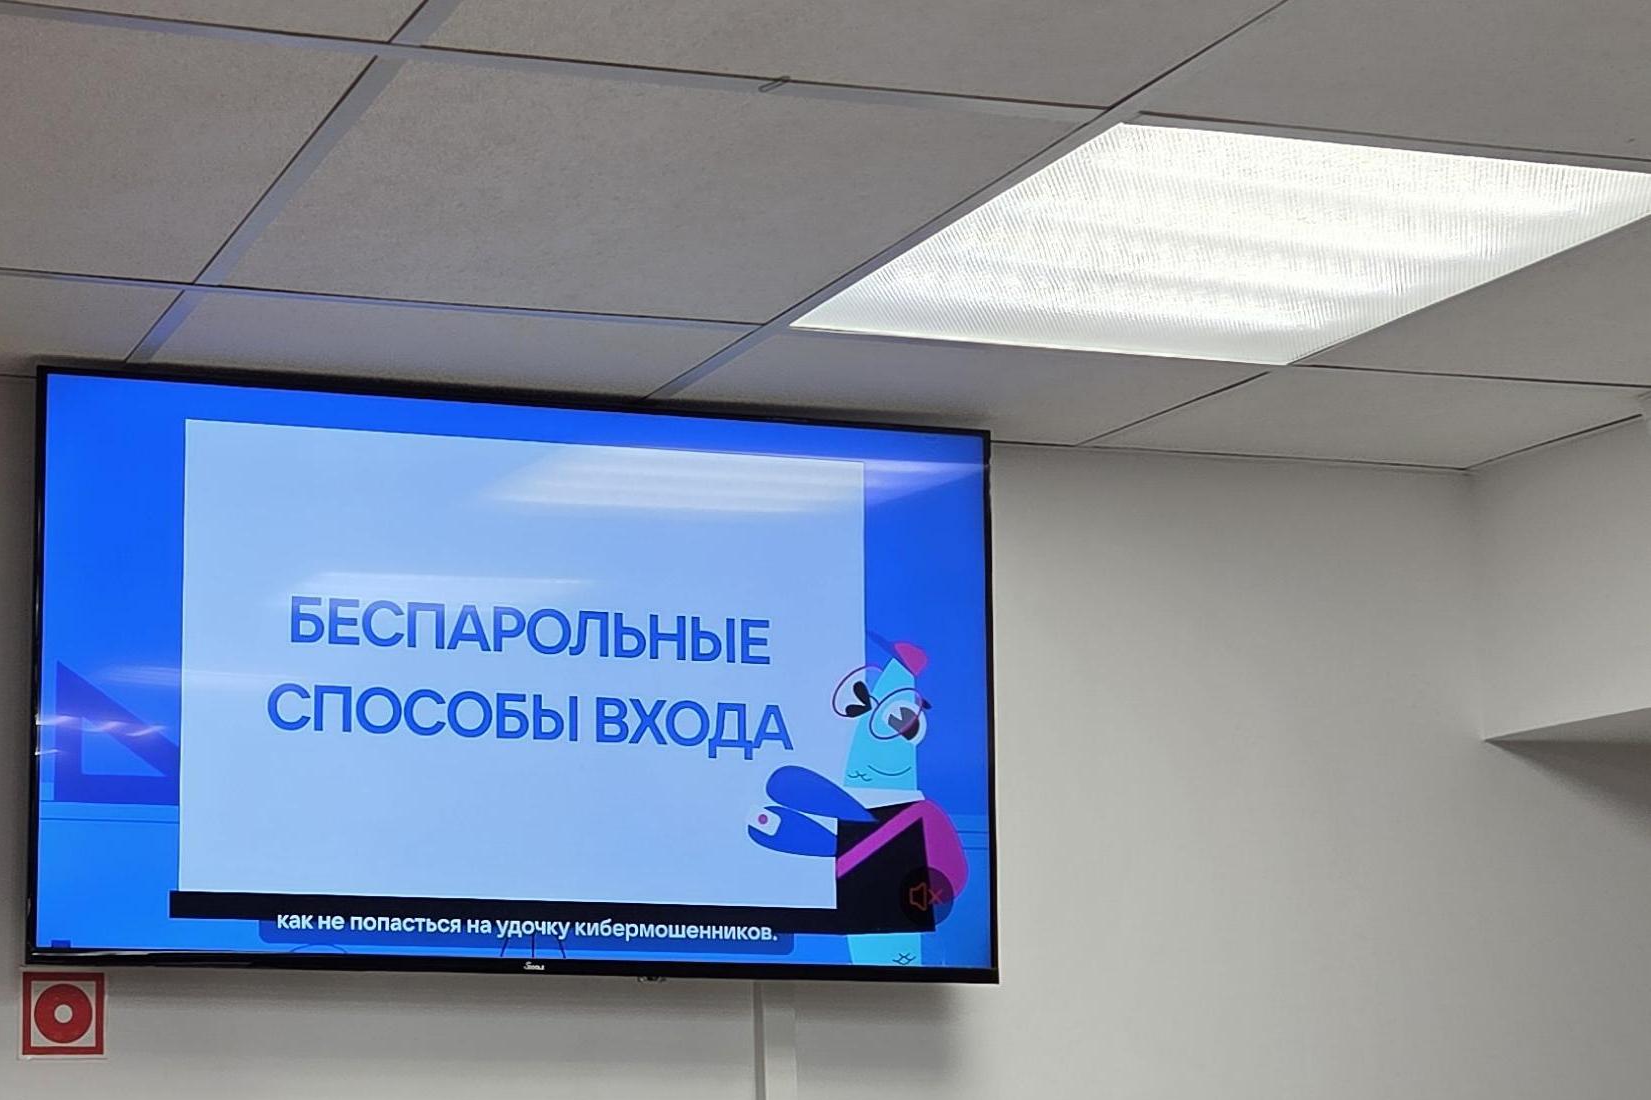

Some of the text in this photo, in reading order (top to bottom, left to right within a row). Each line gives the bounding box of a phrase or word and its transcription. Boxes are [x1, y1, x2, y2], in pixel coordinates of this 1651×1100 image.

[290, 595, 771, 665] БЕСПАРОЛЬНЫЕ
[266, 683, 794, 760] СПОСОБЫ ВХОДА
[276, 912, 779, 942] как не попасться на удочку кибермошенников.
